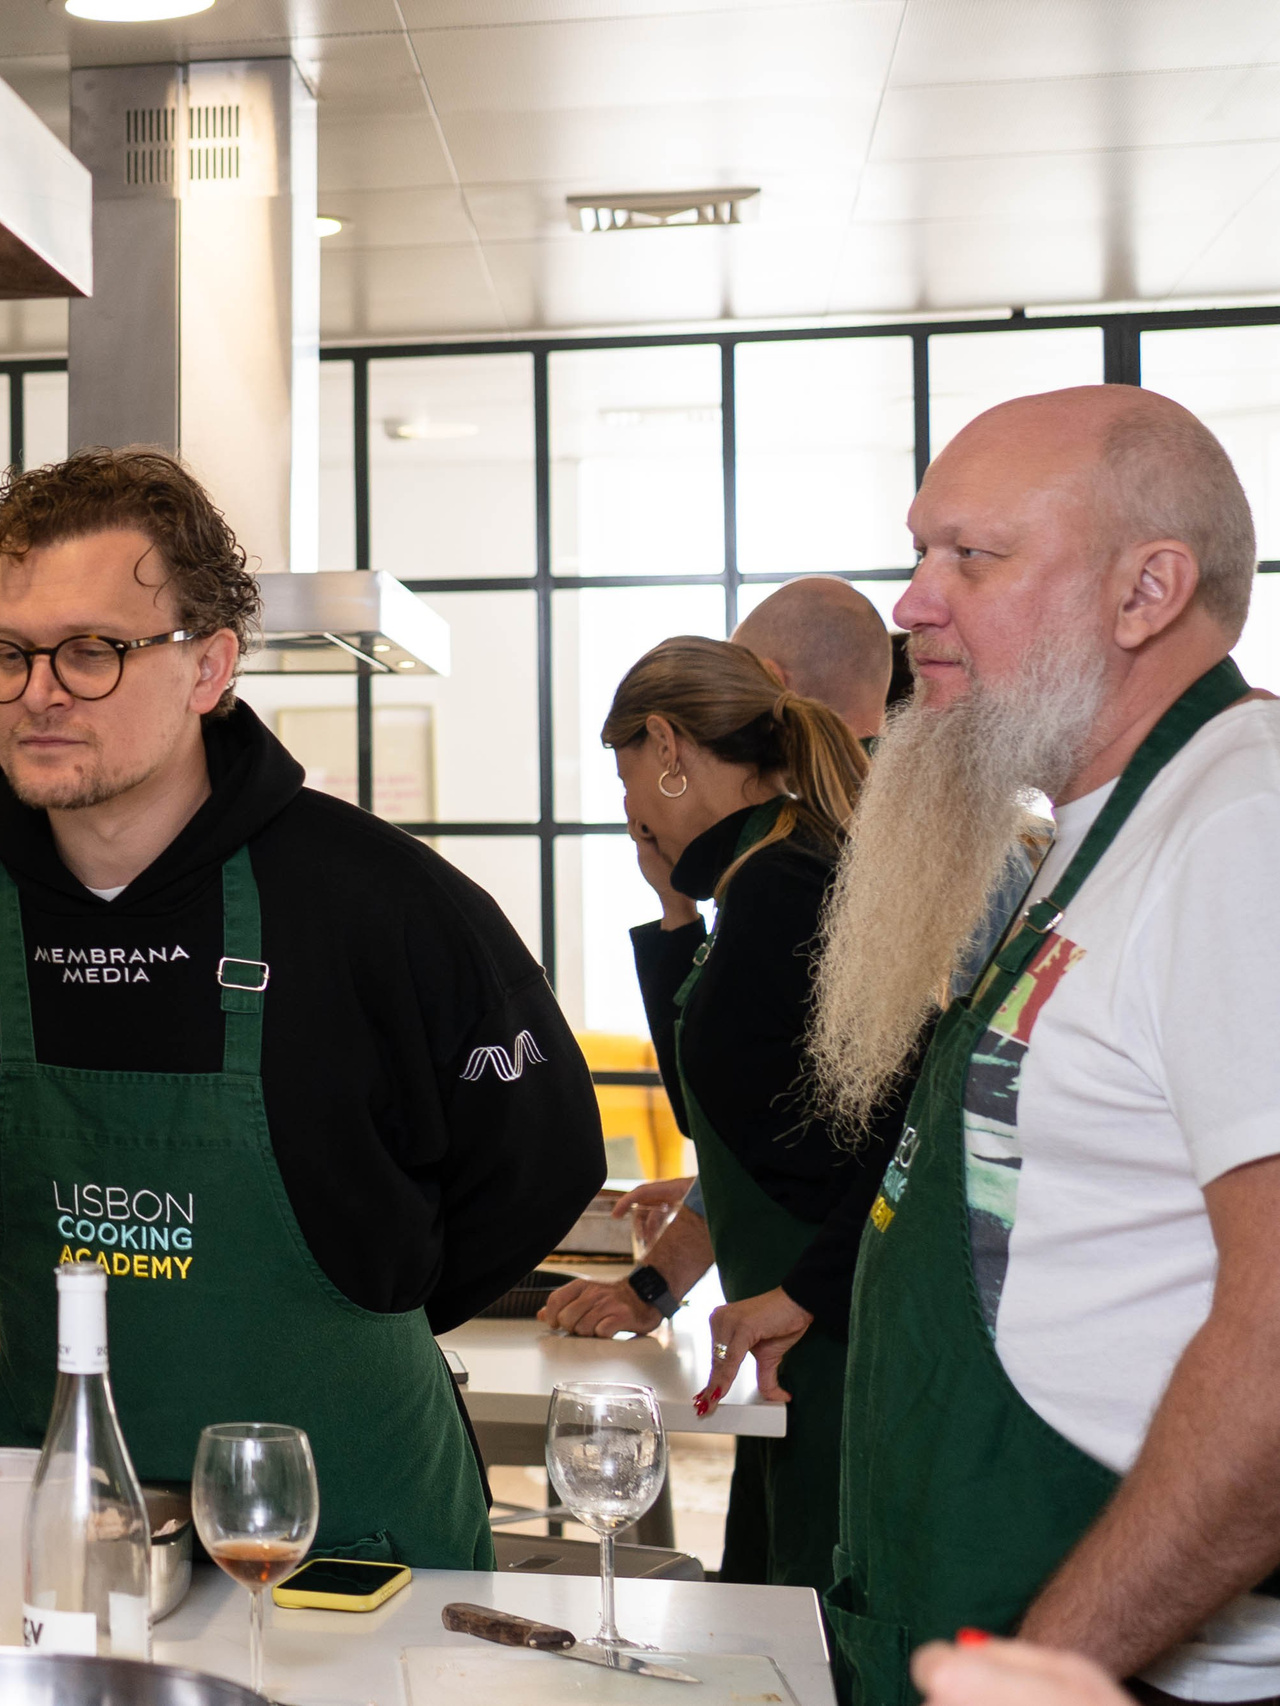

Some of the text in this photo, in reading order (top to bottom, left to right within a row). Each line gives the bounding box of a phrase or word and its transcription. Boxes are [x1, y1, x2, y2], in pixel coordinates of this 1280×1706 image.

[34, 945, 190, 964] MEMBRANA
[62, 967, 150, 983] MEDIA
[53, 1181, 193, 1224] LISBON
[57, 1215, 193, 1251] COOKING
